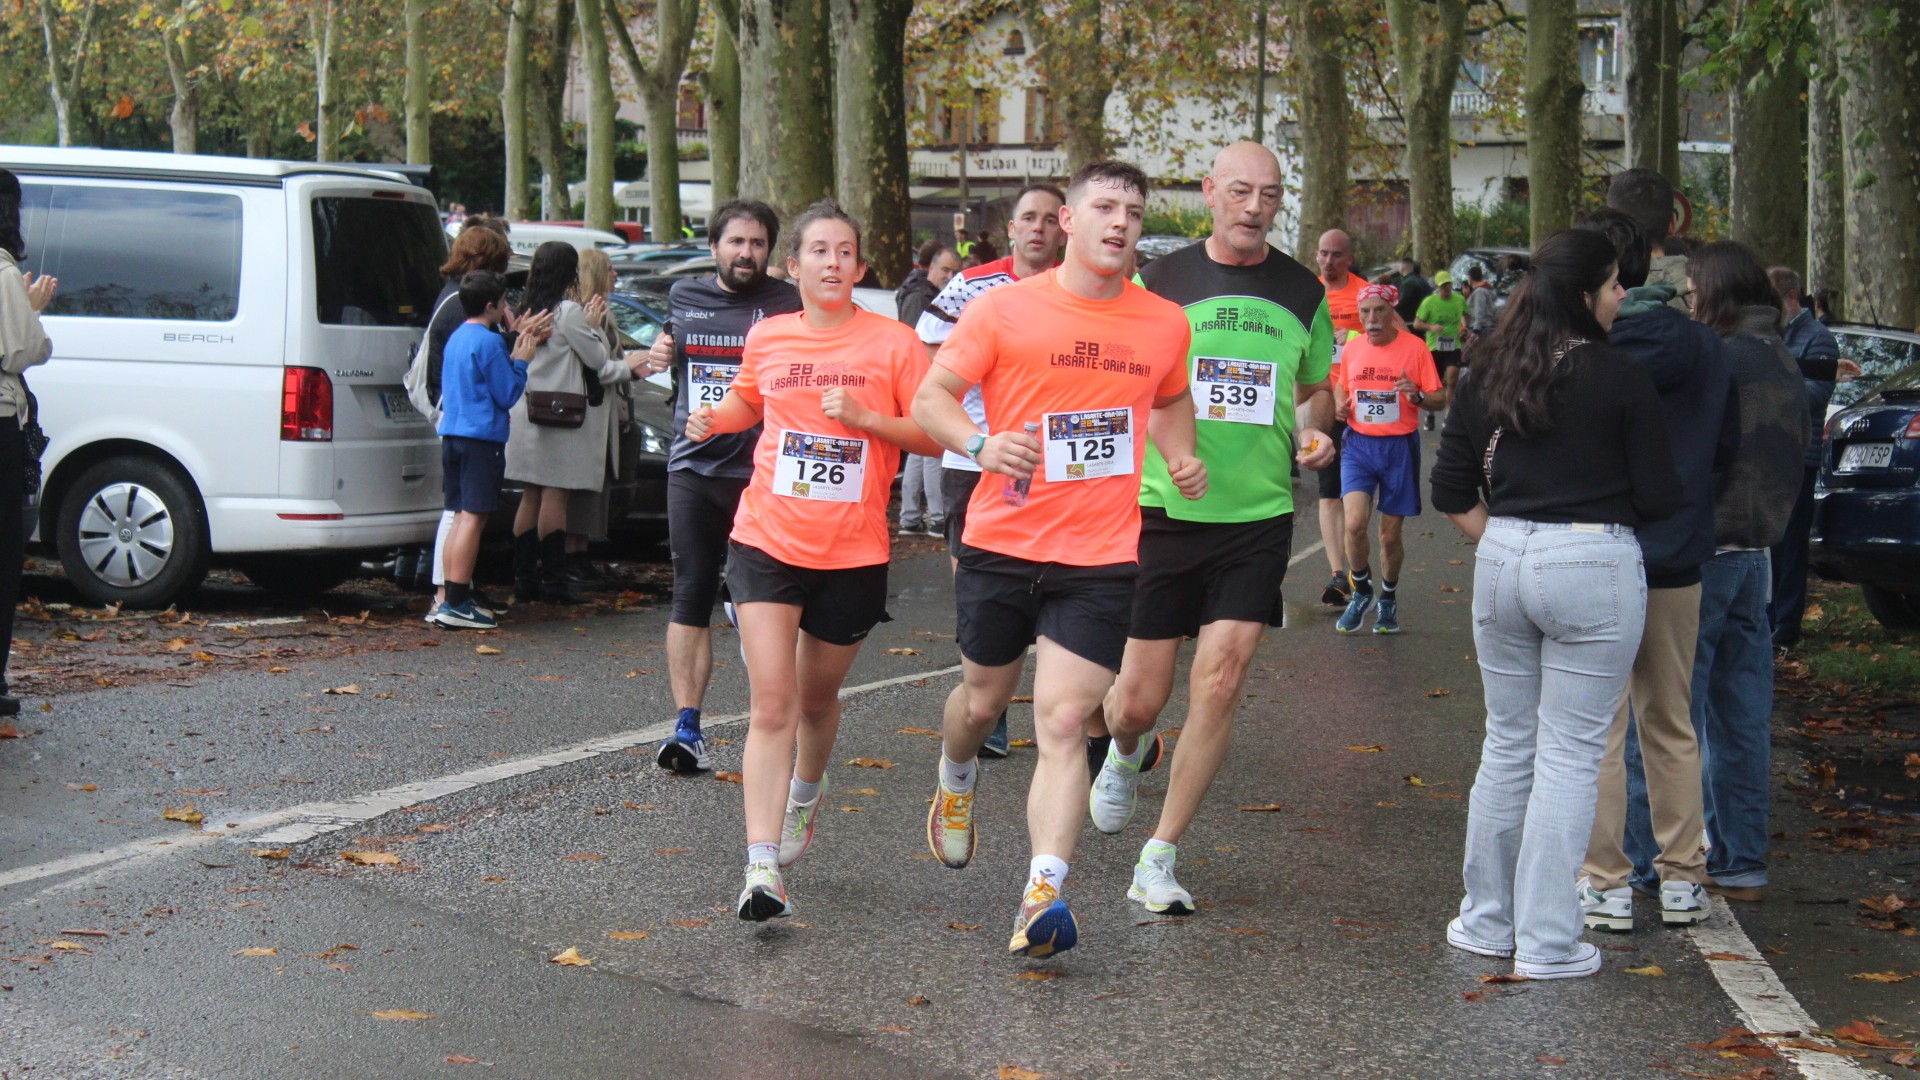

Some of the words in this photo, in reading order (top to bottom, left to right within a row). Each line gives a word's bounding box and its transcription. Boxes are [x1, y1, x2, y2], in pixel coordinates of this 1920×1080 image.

[1216, 307, 1239, 320] 25
[163, 333, 234, 344] BEACH
[1075, 340, 1100, 357] 28
[789, 363, 814, 376] 28
[1362, 367, 1376, 375] 28
[700, 385, 732, 402] 29
[1209, 384, 1258, 407] 539
[1368, 404, 1385, 416] 28
[1067, 437, 1115, 462] 125
[1869, 446, 1890, 464] FSP
[797, 460, 845, 485] 126
